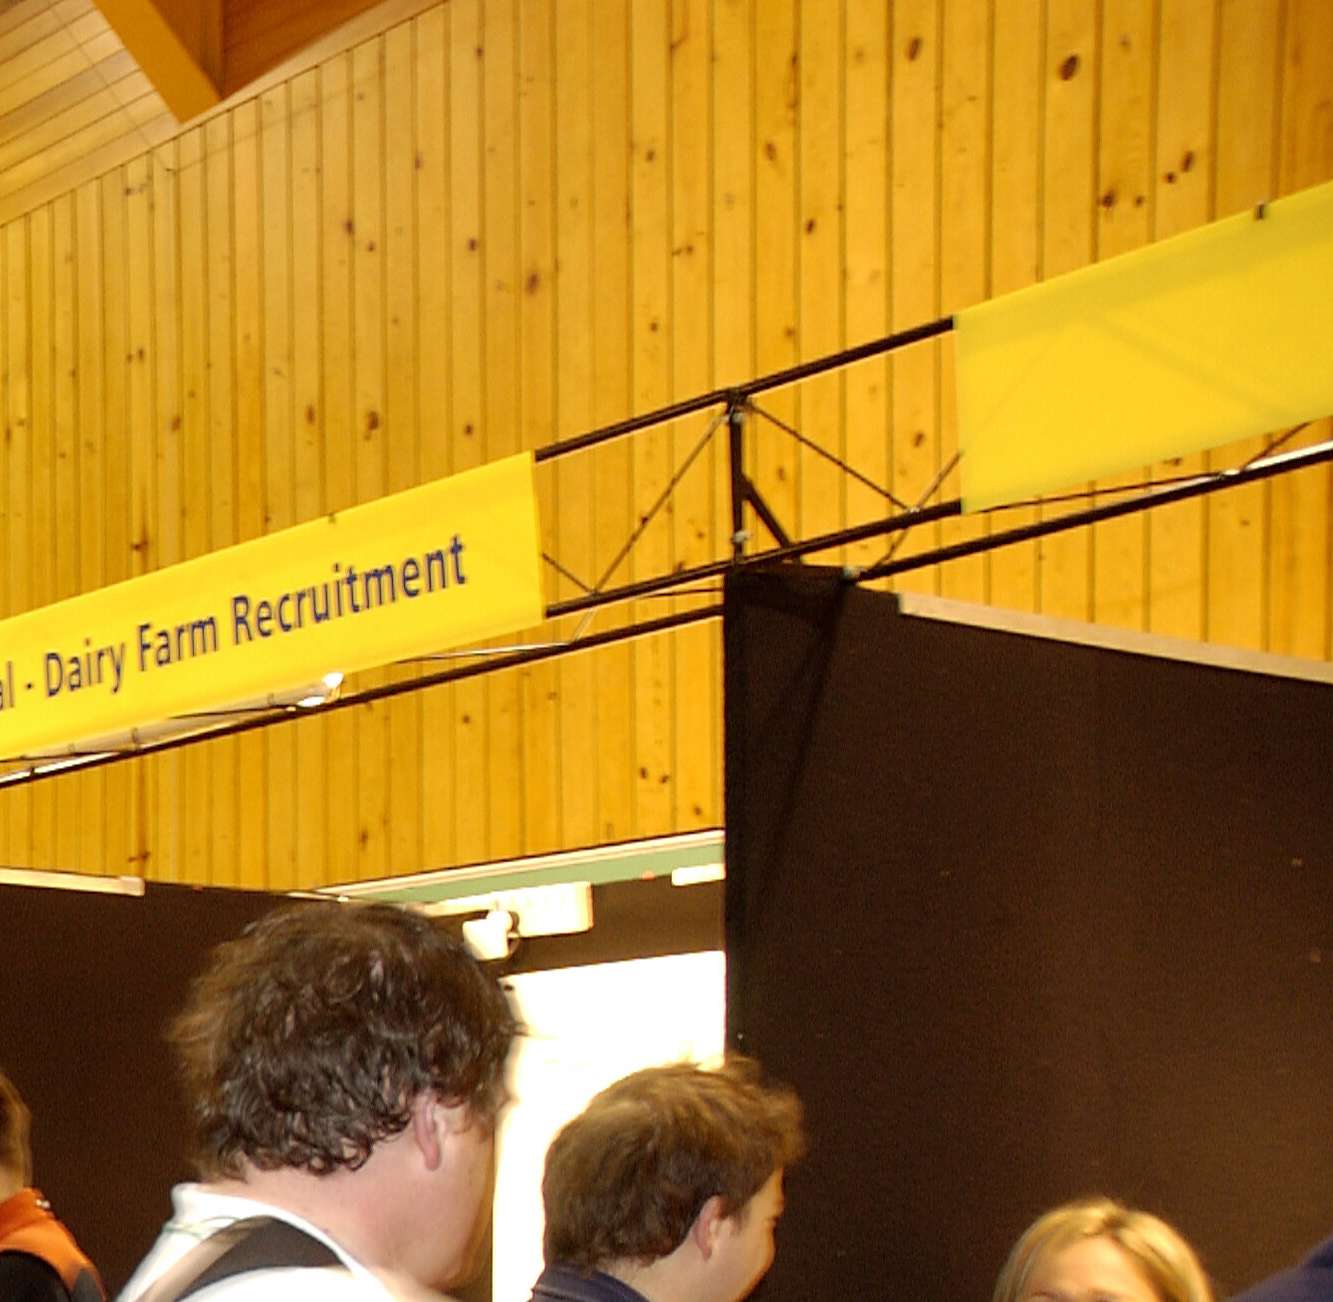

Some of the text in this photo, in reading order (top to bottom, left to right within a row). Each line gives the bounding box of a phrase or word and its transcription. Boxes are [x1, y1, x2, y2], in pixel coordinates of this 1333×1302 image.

[44, 637, 126, 695] Dairy
[137, 615, 221, 672] Farm
[232, 534, 468, 645] Recruitment
